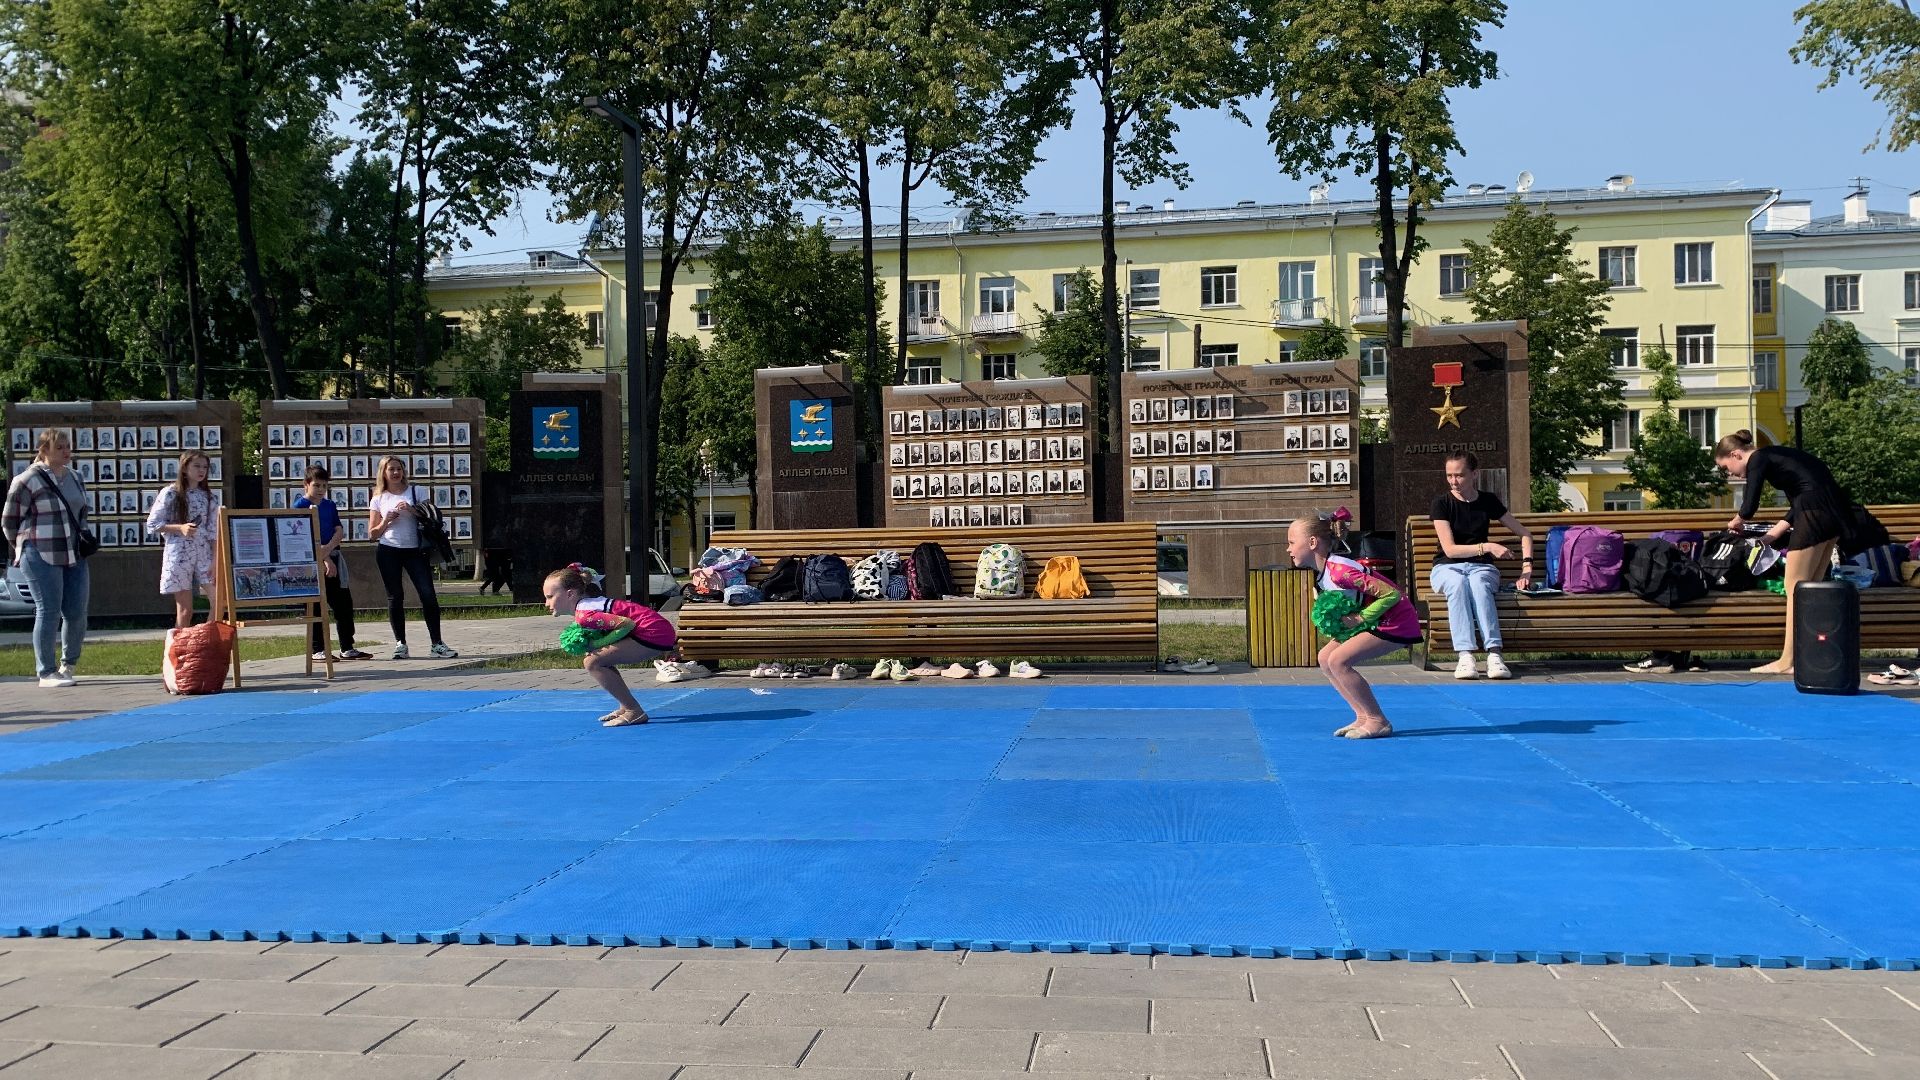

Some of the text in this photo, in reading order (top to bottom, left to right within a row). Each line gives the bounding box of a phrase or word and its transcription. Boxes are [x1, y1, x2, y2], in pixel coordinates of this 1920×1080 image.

[1303, 374, 1336, 385] ТРУДА
[1143, 379, 1248, 393] ПОЧЕТНЫЕ ГРАЖДАНЕ
[1405, 441, 1497, 454] АЛЛЕЯ СЛАВЫ
[779, 466, 848, 477] АЛЛЕЯ СЛАВЫ
[519, 473, 595, 482] АЛЛЕЯ СЛАВЫ
